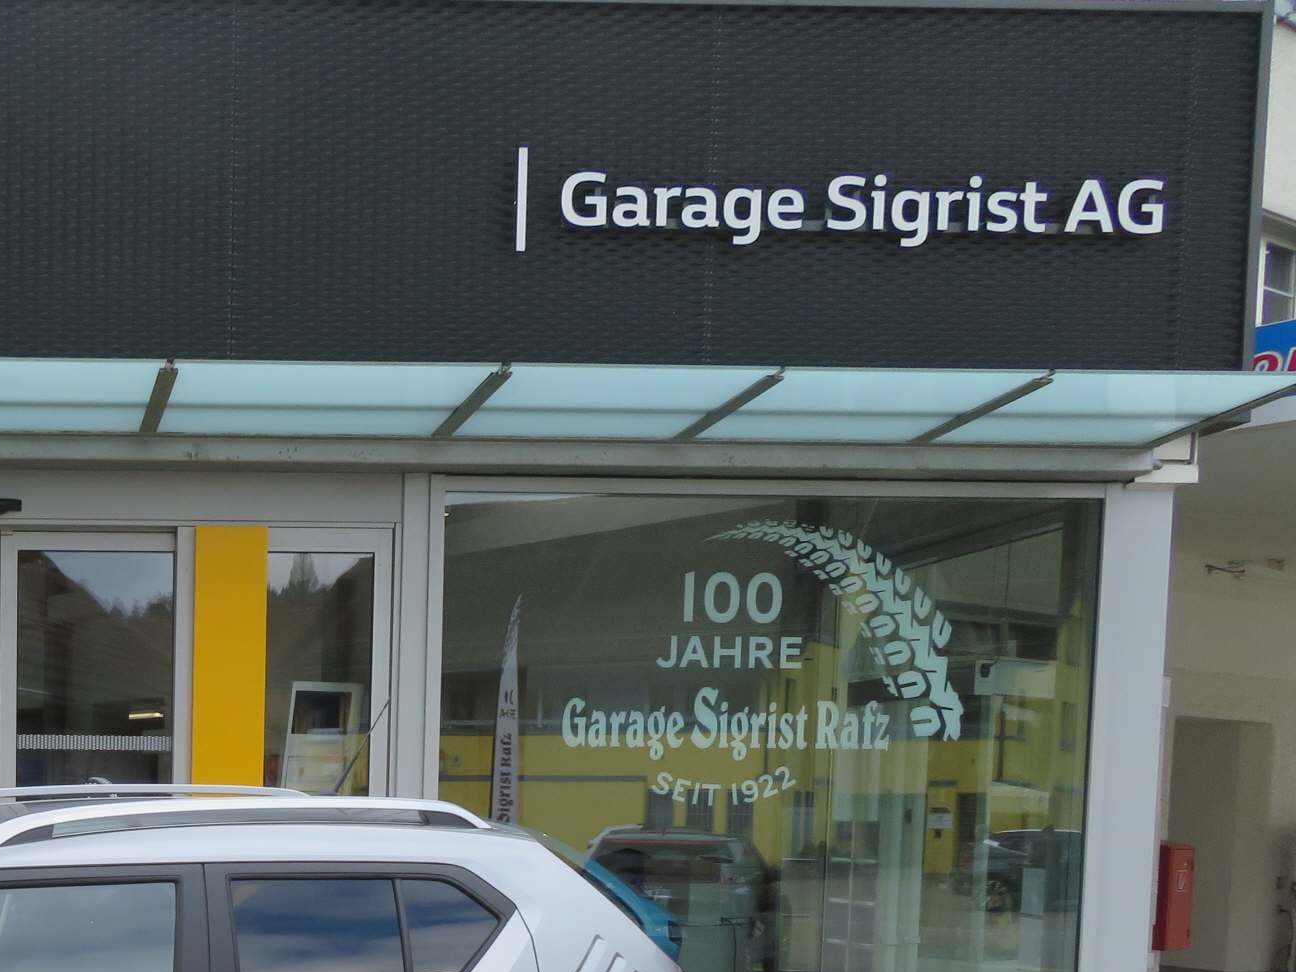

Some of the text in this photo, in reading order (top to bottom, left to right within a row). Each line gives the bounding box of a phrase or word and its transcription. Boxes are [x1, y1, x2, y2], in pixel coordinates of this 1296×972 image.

[560, 170, 1166, 247] Garage Sigrist AG
[683, 571, 783, 624] 100
[656, 635, 802, 669] JAHRE
[562, 697, 685, 760] Garage
[693, 687, 808, 760] Sigrist
[815, 700, 890, 751] Rafz
[652, 766, 797, 807] SEIT 1922
